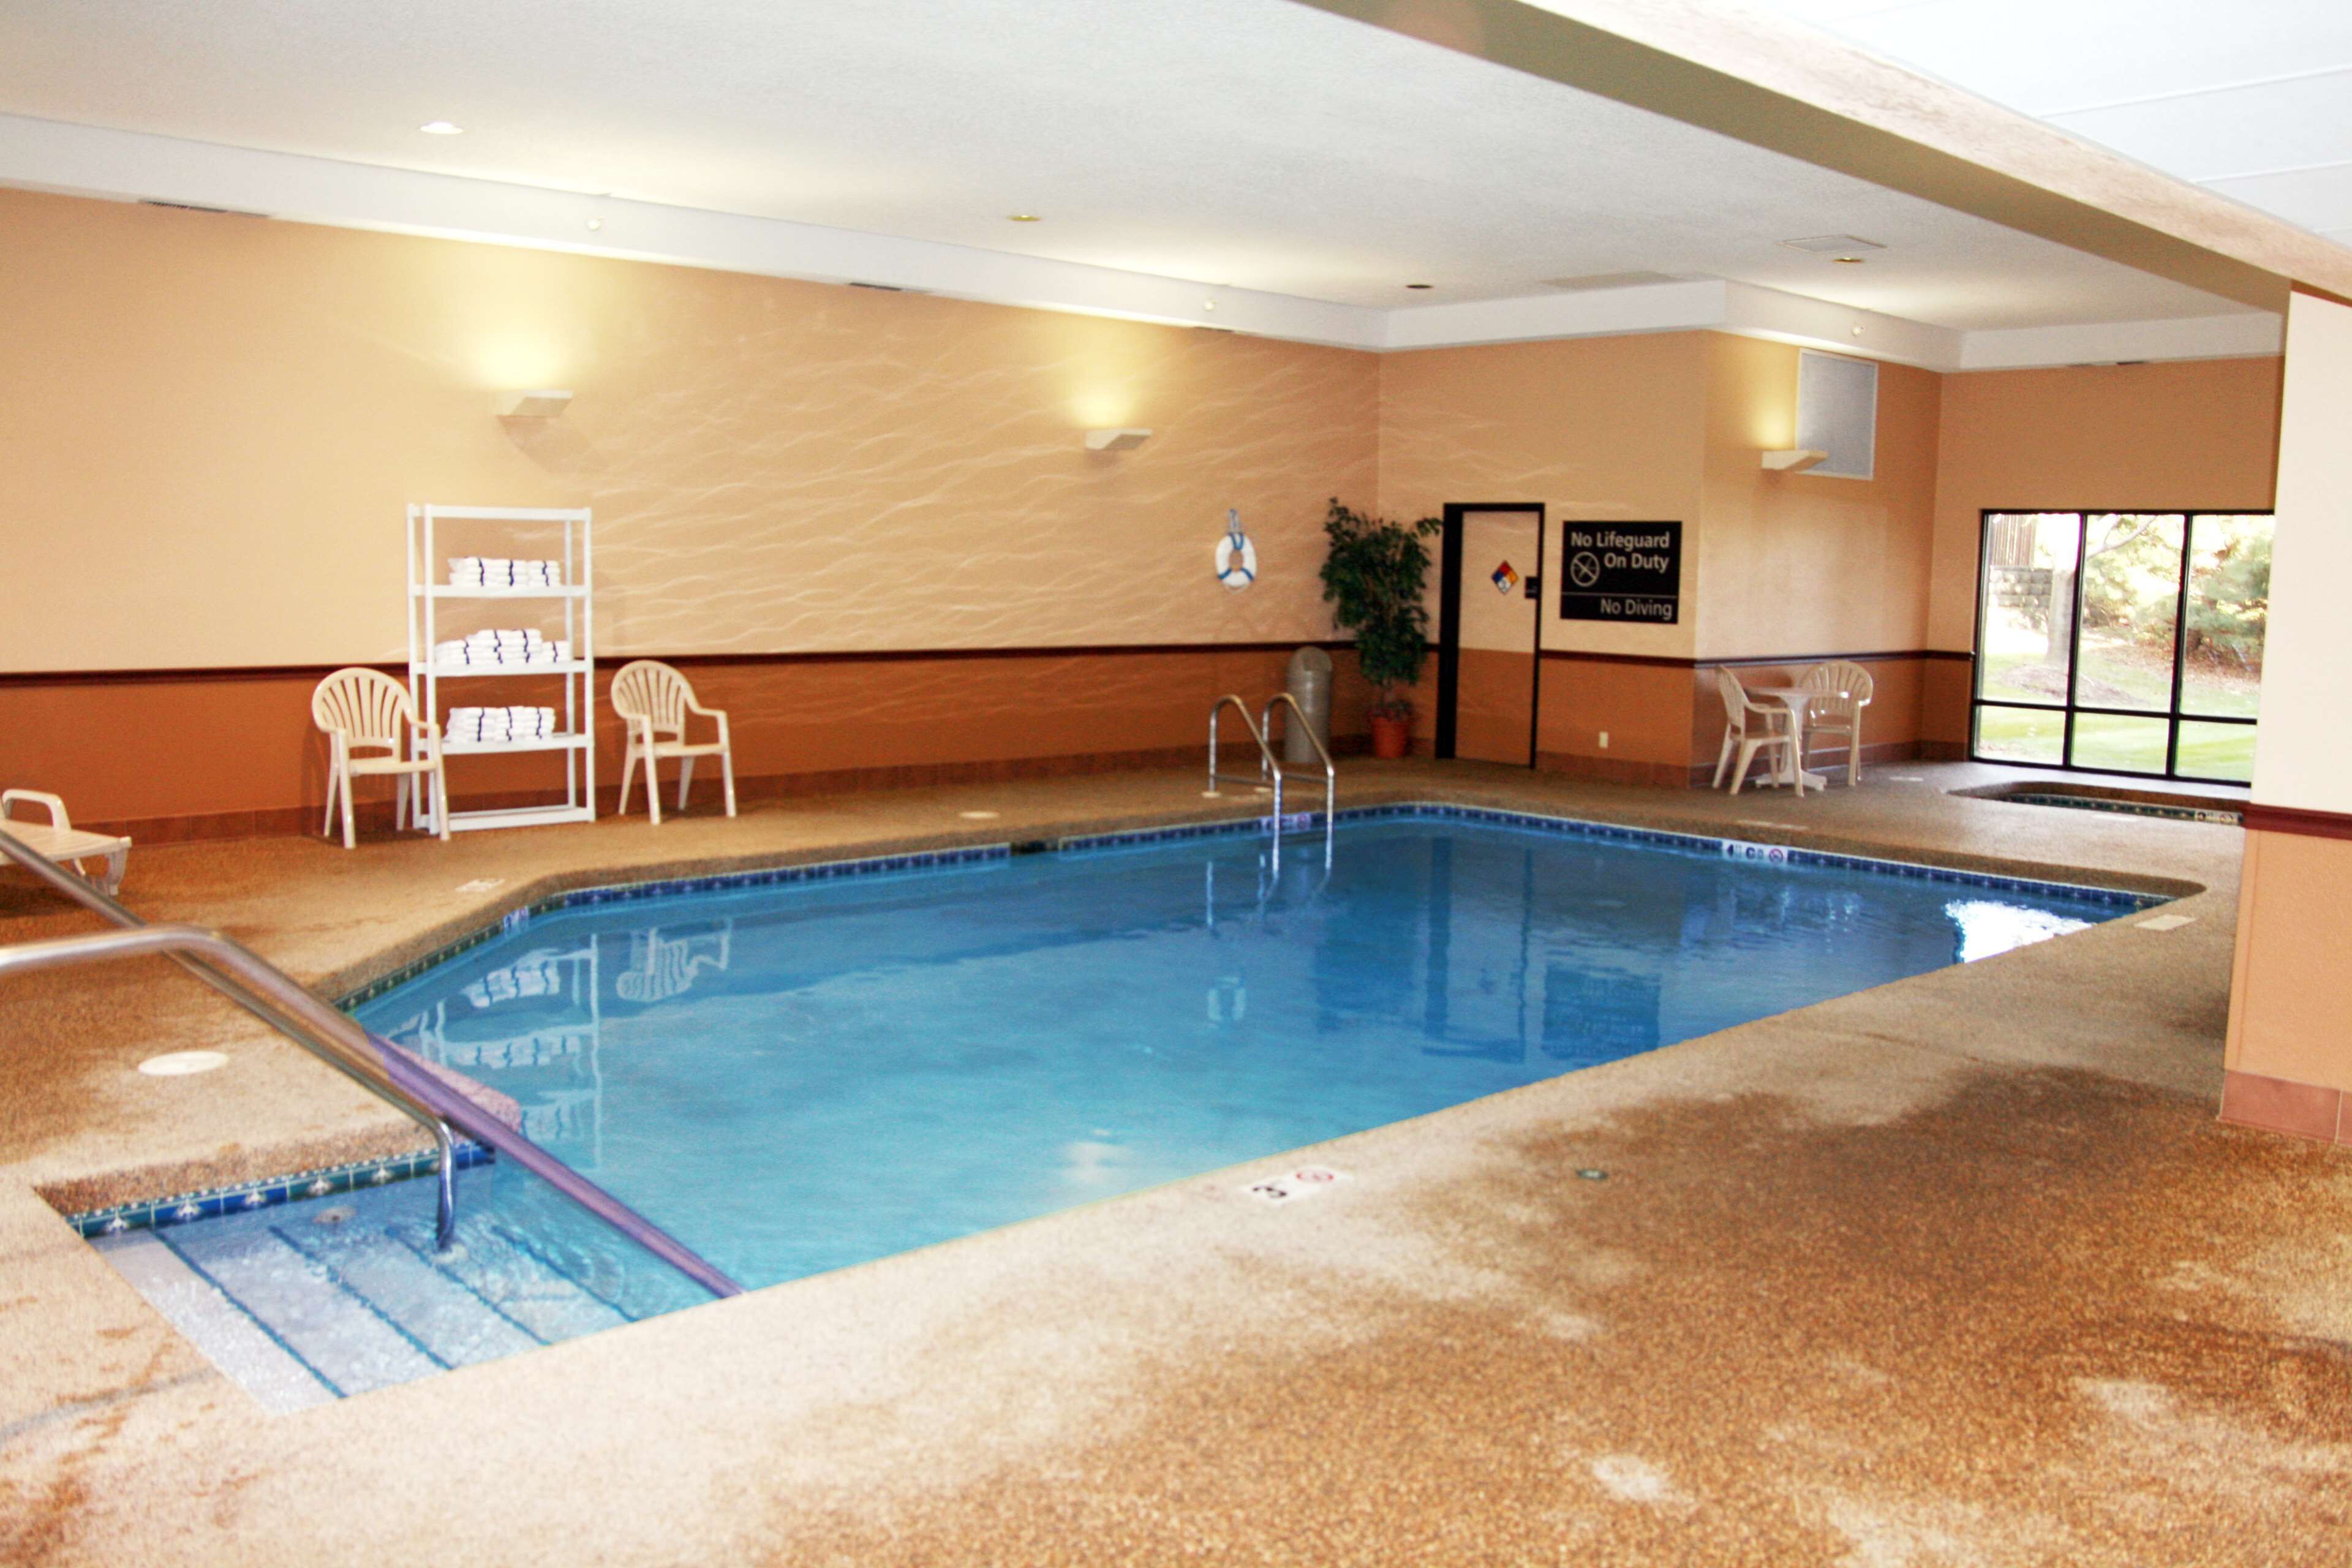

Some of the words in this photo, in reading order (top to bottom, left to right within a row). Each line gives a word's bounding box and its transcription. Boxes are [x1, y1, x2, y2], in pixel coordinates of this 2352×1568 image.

[1571, 532, 1593, 547] No
[1596, 531, 1670, 551] Lifeguard
[1604, 552, 1627, 568] On
[1631, 552, 1669, 574] Duty
[1600, 598, 1621, 614] No
[1625, 598, 1673, 620] Diving
